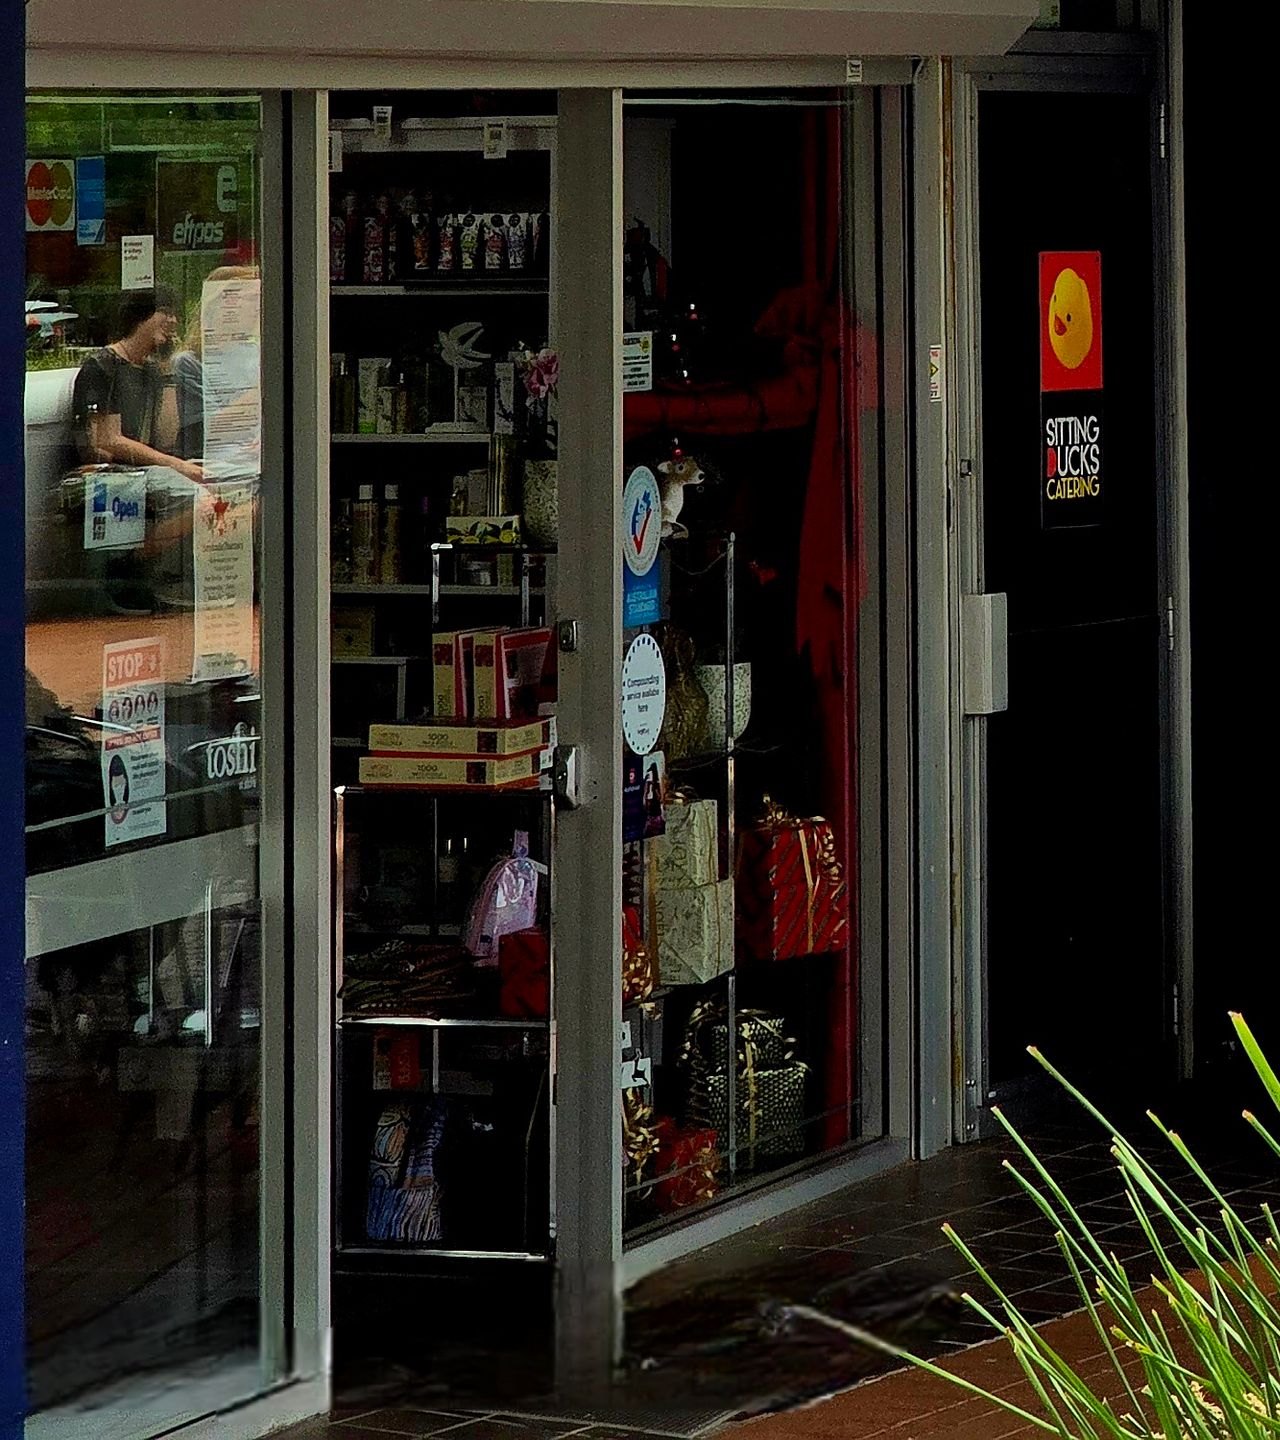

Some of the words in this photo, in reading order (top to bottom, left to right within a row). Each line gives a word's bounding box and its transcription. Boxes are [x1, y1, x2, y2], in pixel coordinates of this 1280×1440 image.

[173, 210, 225, 249] eftpos
[1045, 415, 1100, 446] SITTING
[1046, 443, 1100, 478] DUCKS
[1046, 475, 1100, 500] CATERING
[108, 652, 145, 681] STOP
